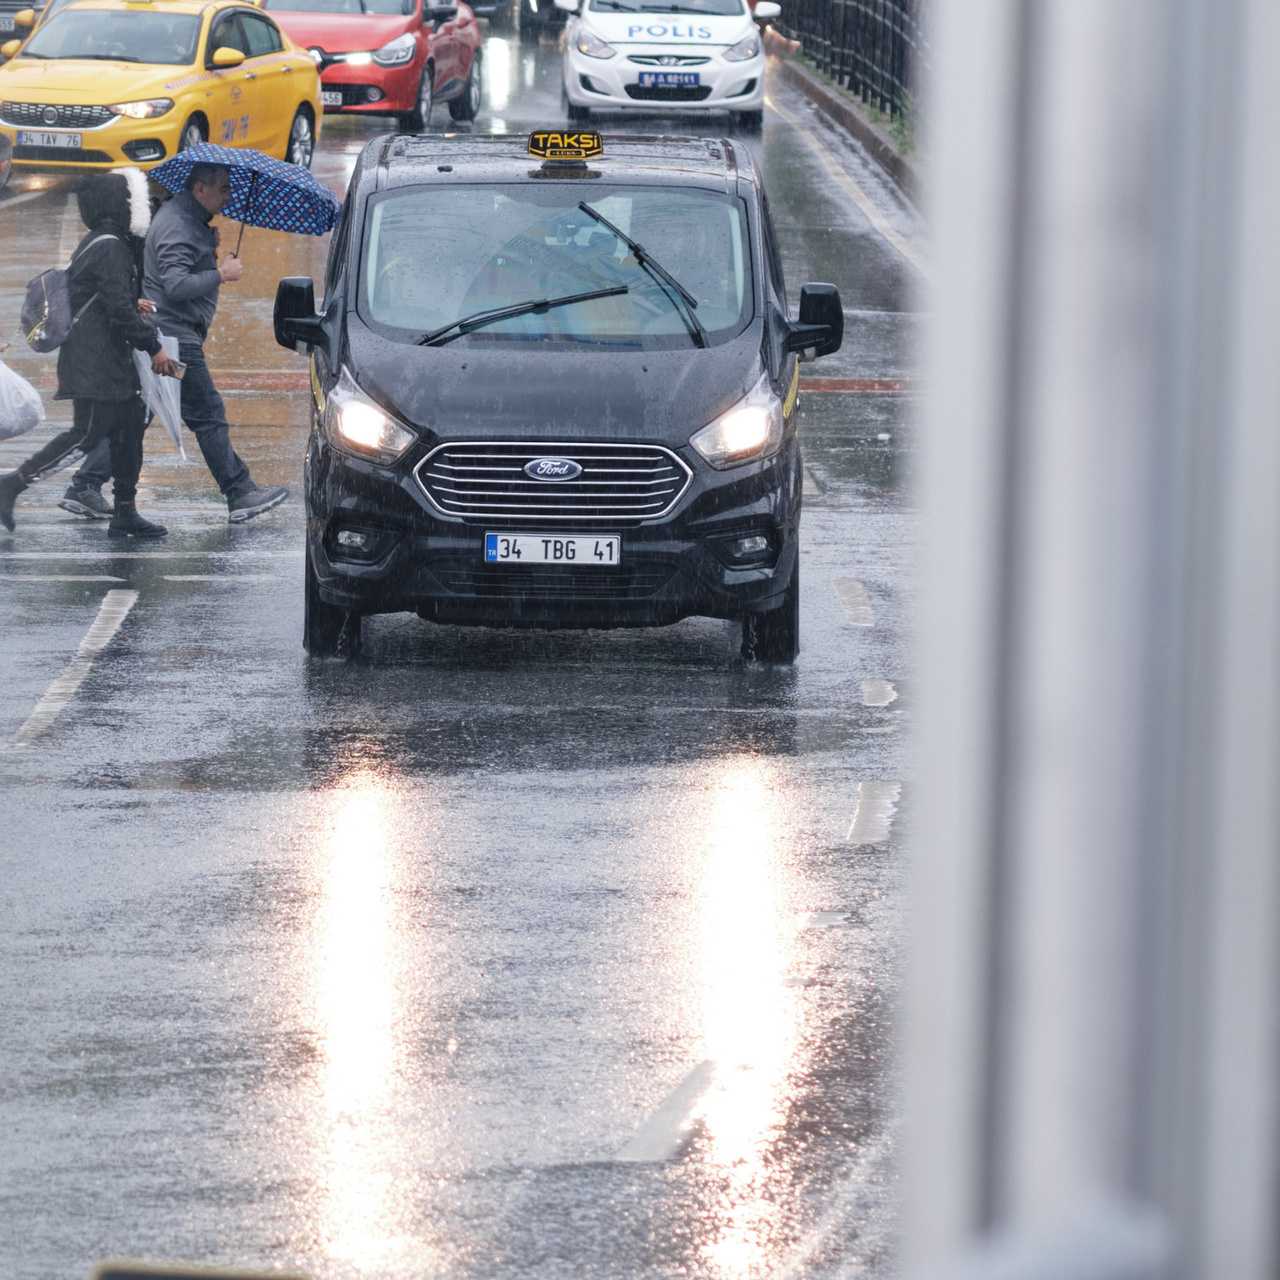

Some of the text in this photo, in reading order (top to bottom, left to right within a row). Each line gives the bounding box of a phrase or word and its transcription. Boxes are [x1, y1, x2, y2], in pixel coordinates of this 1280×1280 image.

[23, 133, 78, 146] 34 TAV 76
[537, 461, 569, 475] Ford
[500, 539, 522, 558] 34
[542, 540, 576, 560] TBG
[594, 541, 613, 561] 41
